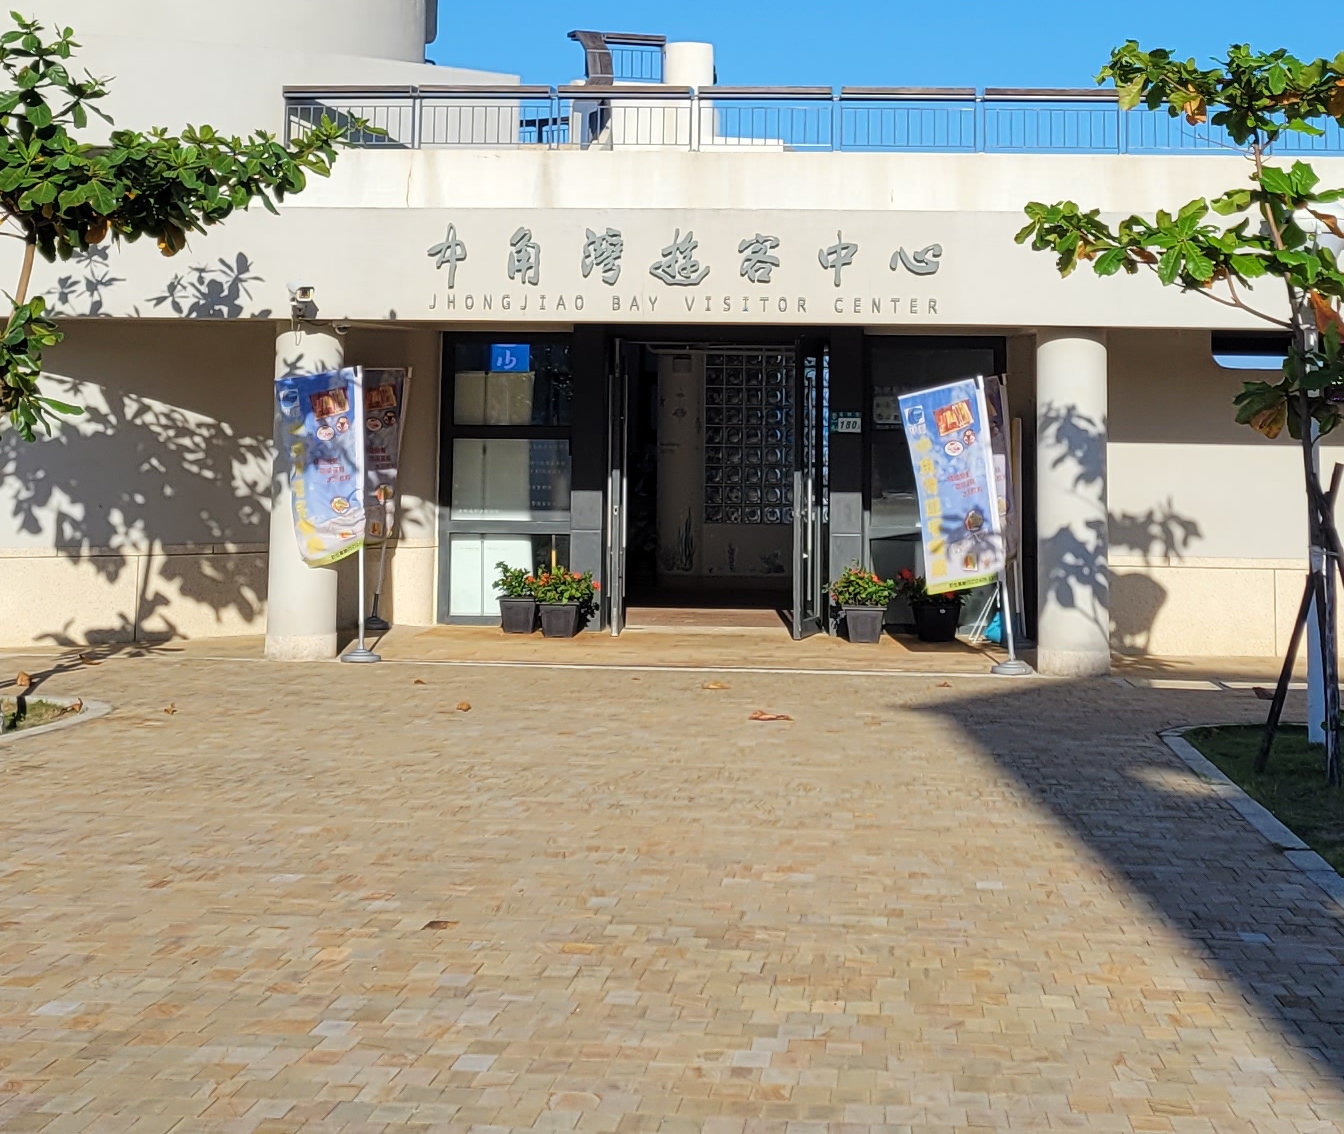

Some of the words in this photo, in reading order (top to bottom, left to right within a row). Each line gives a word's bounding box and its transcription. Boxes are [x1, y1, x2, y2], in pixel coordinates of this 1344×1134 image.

[429, 293, 585, 312] JHONGJIAO
[611, 295, 658, 312] BAY
[684, 295, 807, 314] VISITOR
[834, 296, 938, 315] CENTER
